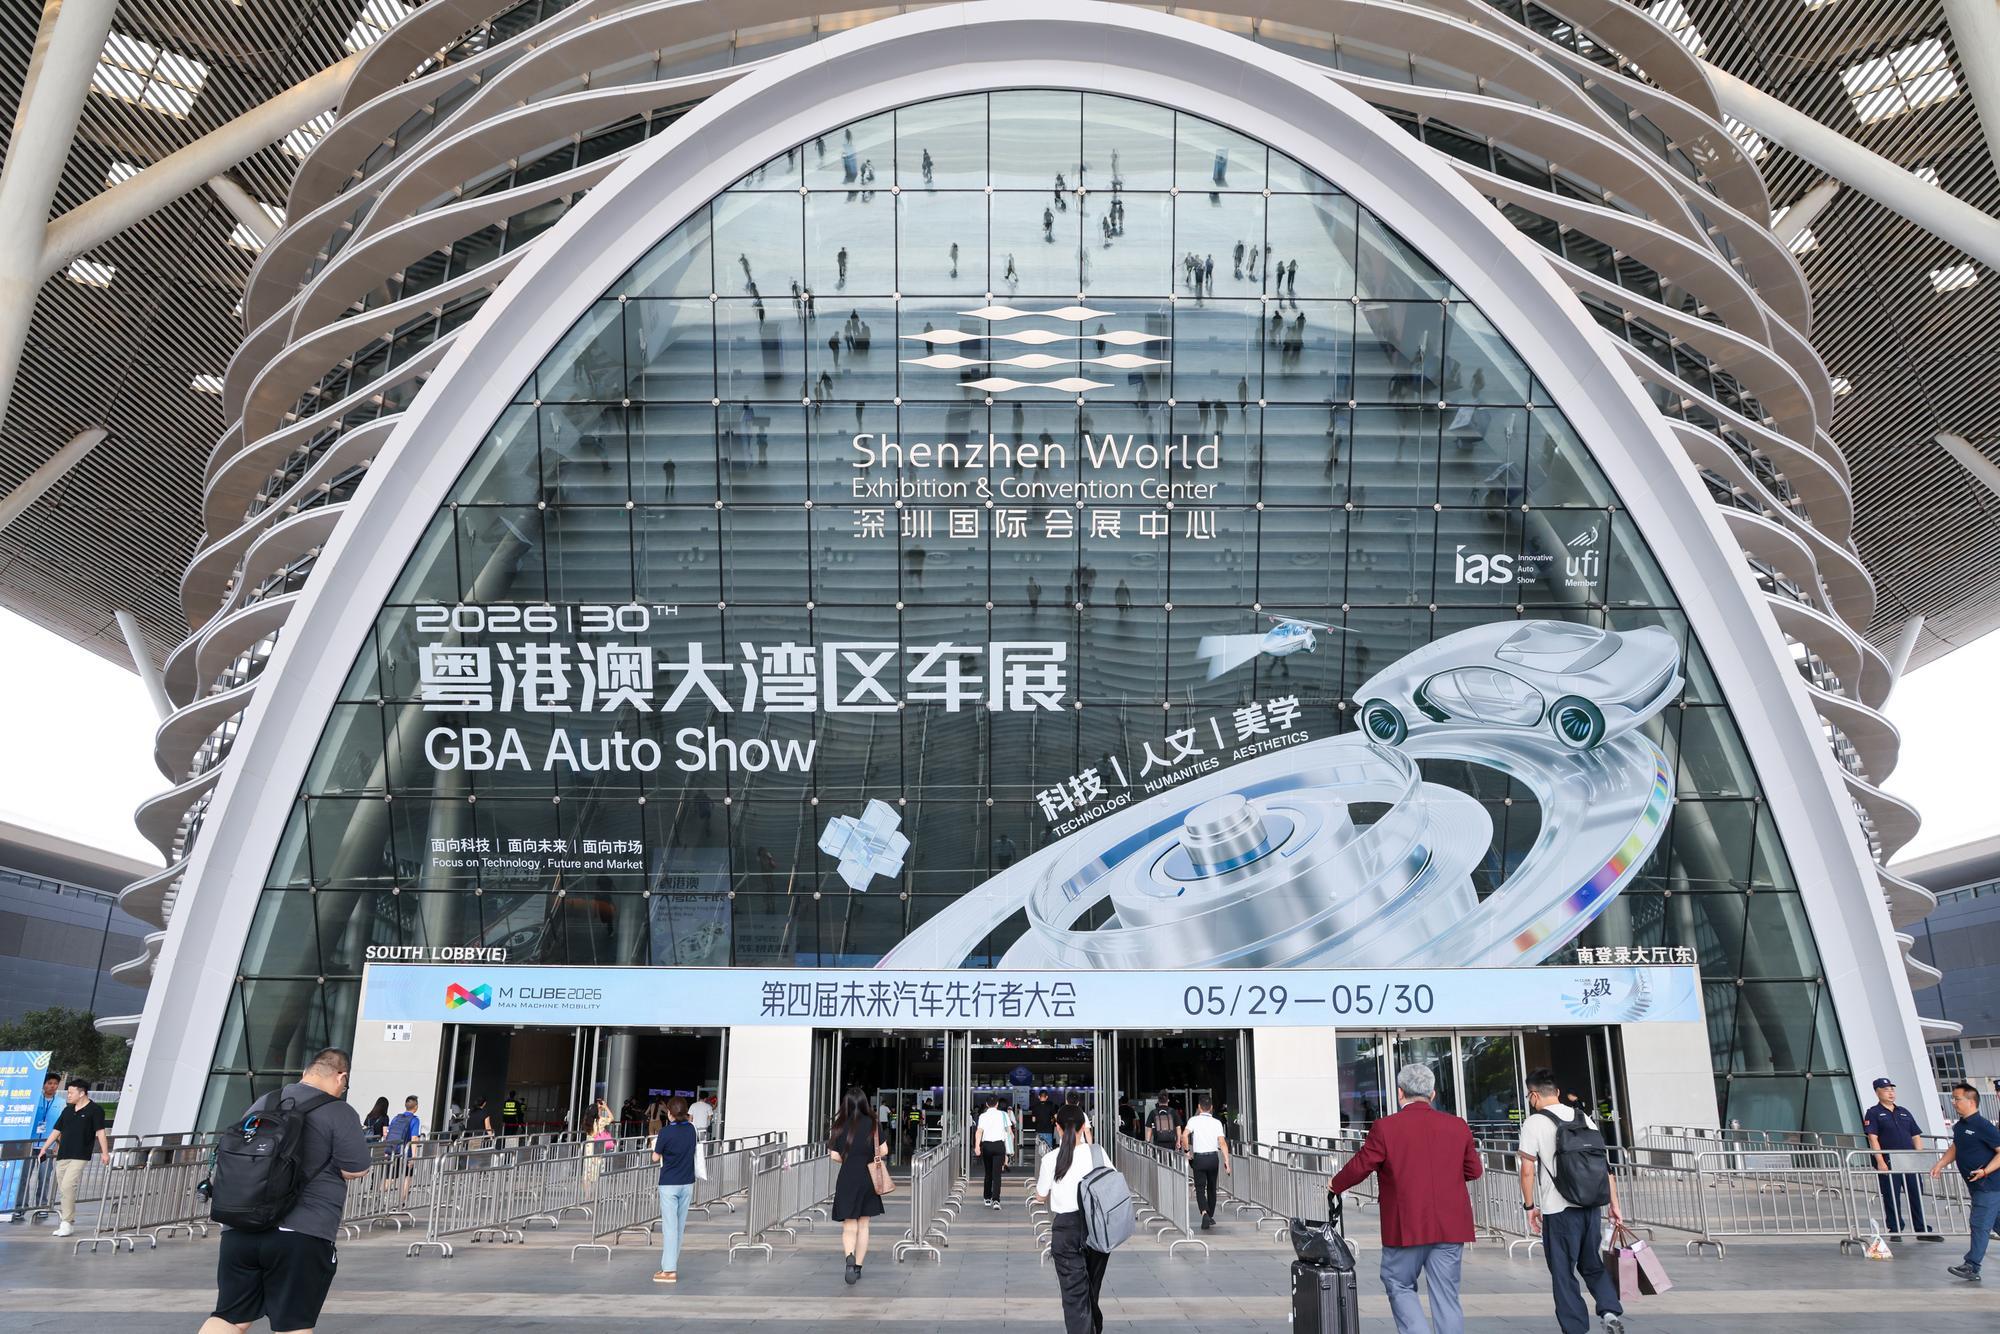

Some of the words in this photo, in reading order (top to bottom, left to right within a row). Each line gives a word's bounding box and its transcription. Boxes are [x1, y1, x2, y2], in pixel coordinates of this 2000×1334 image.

[853, 433, 1066, 469] Shenzhen
[1084, 433, 1220, 470] World
[852, 476, 967, 498] Exhibition
[975, 476, 994, 498] &
[1000, 477, 1133, 499] Convention
[1140, 478, 1218, 499] Center
[853, 508, 1217, 539] 深圳国际会展中心
[1455, 544, 1514, 585] ias
[1517, 565, 1534, 573] Auto
[1566, 550, 1599, 577] ufi
[1517, 576, 1536, 584] Show
[1565, 578, 1598, 587] Member
[417, 641, 1067, 713] 粤港澳大湾区车展
[424, 726, 532, 771] GBA
[543, 727, 662, 772] Auto
[675, 726, 817, 772] Show
[1036, 767, 1108, 822] 科技
[1139, 727, 1204, 777] 人文
[1233, 694, 1302, 741] 美学
[1053, 792, 1132, 837] TECHNOLOGY
[1145, 757, 1220, 794] HUMANITIES
[1233, 730, 1309, 761] AESTHETICS
[431, 838, 491, 853] 面向科技
[508, 838, 568, 853] 面向未来
[582, 839, 643, 855] 面向市场
[432, 857, 464, 868] Focus
[465, 859, 479, 868] on
[547, 858, 582, 869] Future
[583, 859, 604, 869] and
[606, 859, 643, 870] Market
[365, 945, 424, 961] SOUTH
[431, 946, 507, 963] LOBBY(E)
[1576, 946, 1698, 964] 南登录大厅(东)
[499, 987, 514, 999] M
[760, 980, 1076, 1018] 第四届未来汽车先行者大会
